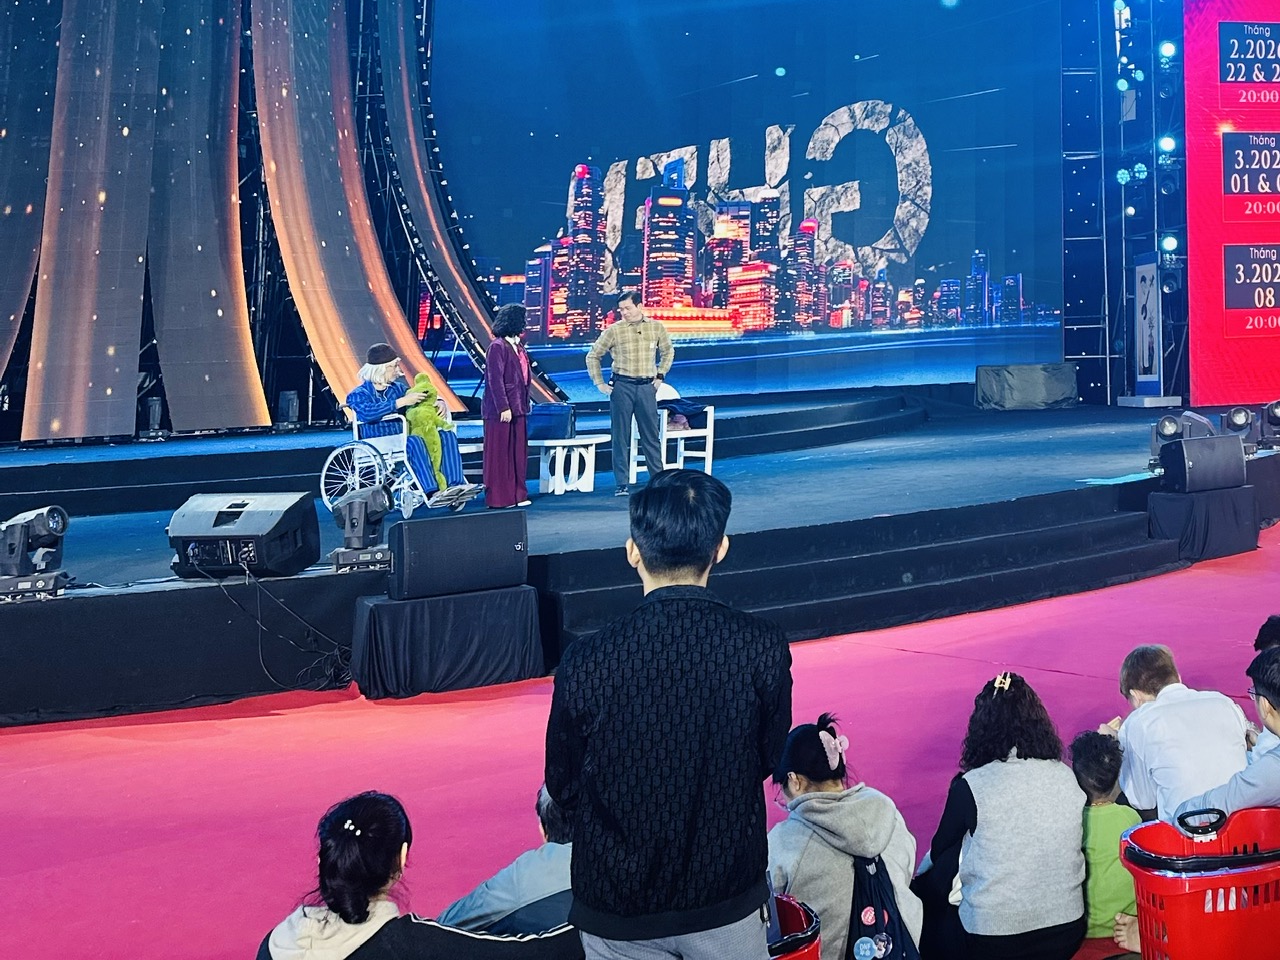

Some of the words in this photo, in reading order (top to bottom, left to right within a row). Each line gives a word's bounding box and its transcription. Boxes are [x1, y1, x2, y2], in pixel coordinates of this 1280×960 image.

[1244, 24, 1271, 37] Tháng
[1226, 62, 1247, 82] 22
[1252, 63, 1268, 82] &
[1238, 90, 1280, 103] 20:00
[1249, 134, 1276, 147] Tháng
[1230, 174, 1250, 194] 01
[1258, 174, 1272, 194] &
[1250, 248, 1277, 261] Tháng
[1254, 287, 1276, 308] 08
